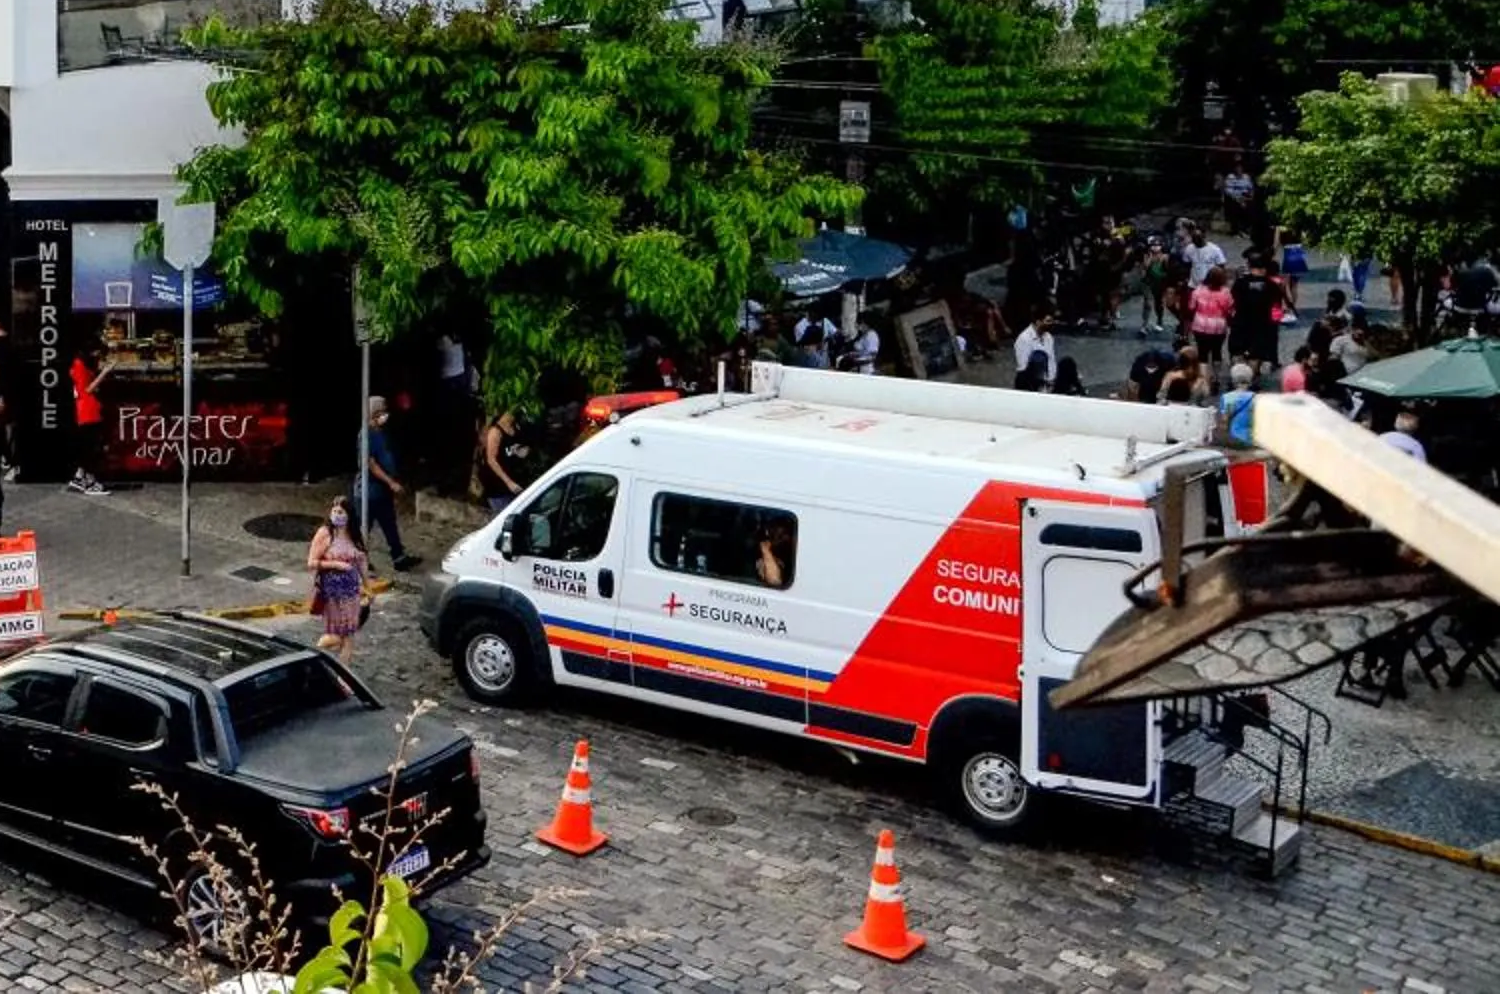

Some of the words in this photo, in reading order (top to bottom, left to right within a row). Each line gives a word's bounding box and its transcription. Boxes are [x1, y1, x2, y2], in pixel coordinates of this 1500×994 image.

[26, 220, 68, 231] HOTEL
[39, 242, 59, 429] METROPOLE
[119, 407, 252, 441] Prazeres
[155, 441, 236, 466] Mnas
[533, 575, 587, 594] MILITAR
[936, 558, 1020, 589] SEGURA
[933, 584, 1020, 616] COMUNI
[689, 603, 787, 635] SEGURANÇA
